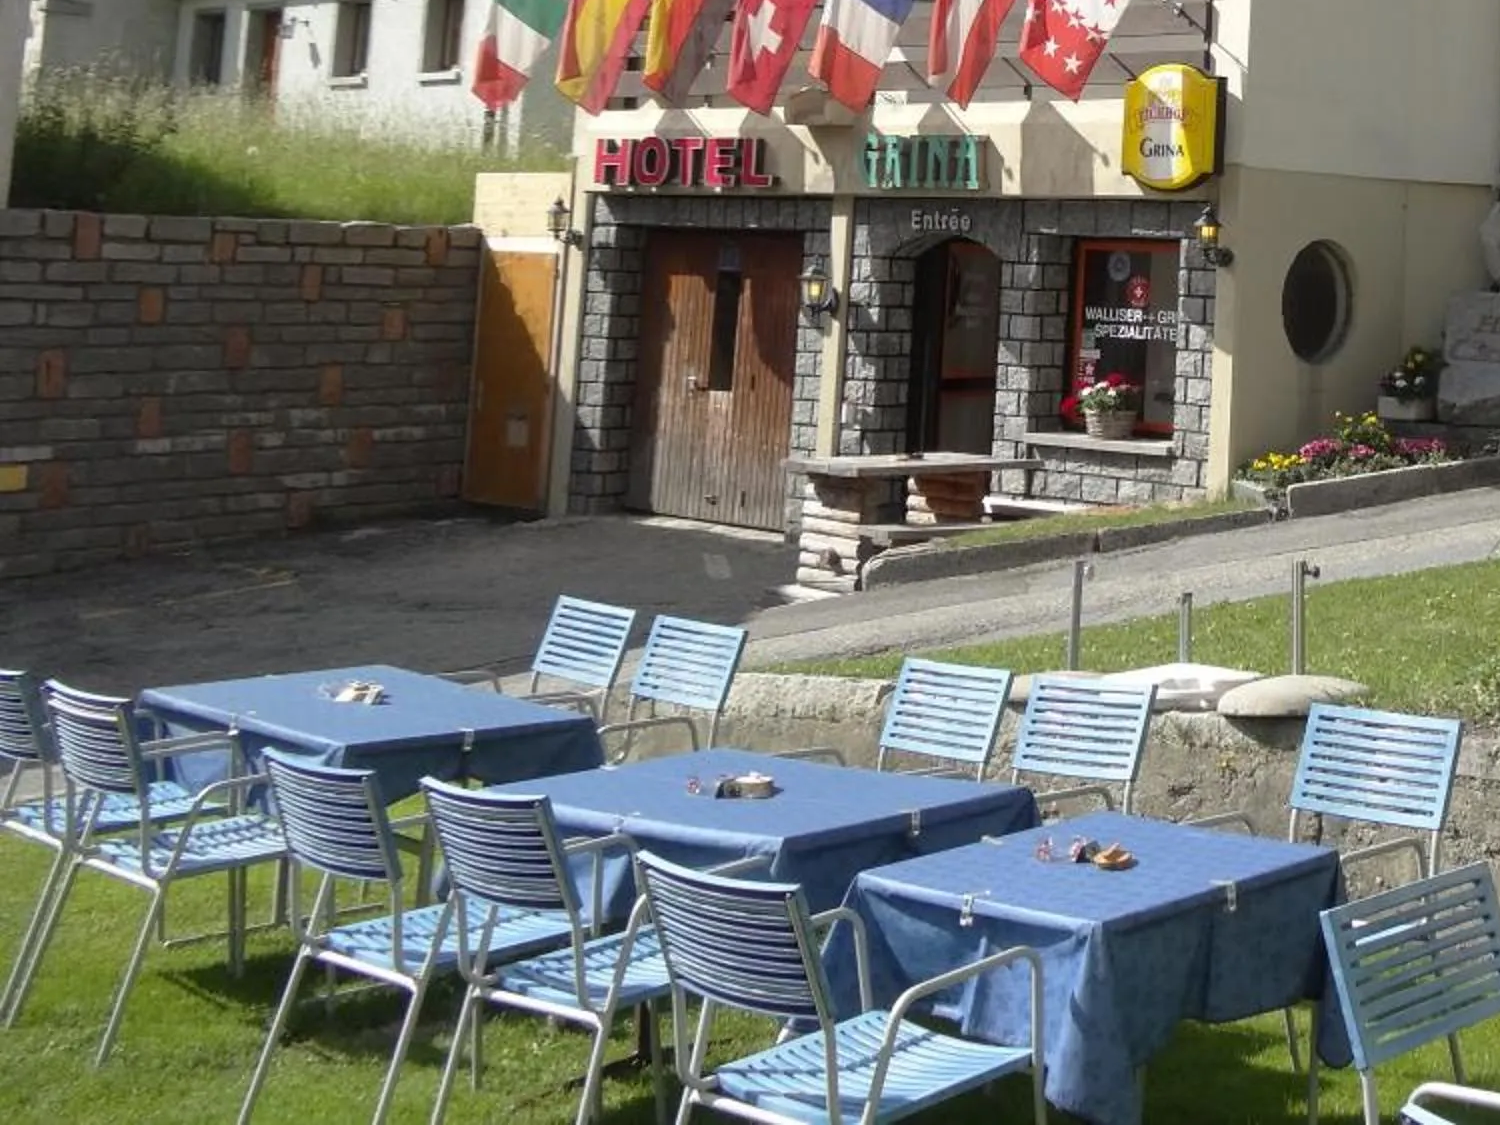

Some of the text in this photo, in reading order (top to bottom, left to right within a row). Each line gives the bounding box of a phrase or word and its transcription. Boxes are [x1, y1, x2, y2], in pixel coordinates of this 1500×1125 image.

[594, 137, 774, 188] HOTEL
[862, 133, 981, 190] GRINA
[911, 207, 972, 231] Entrée
